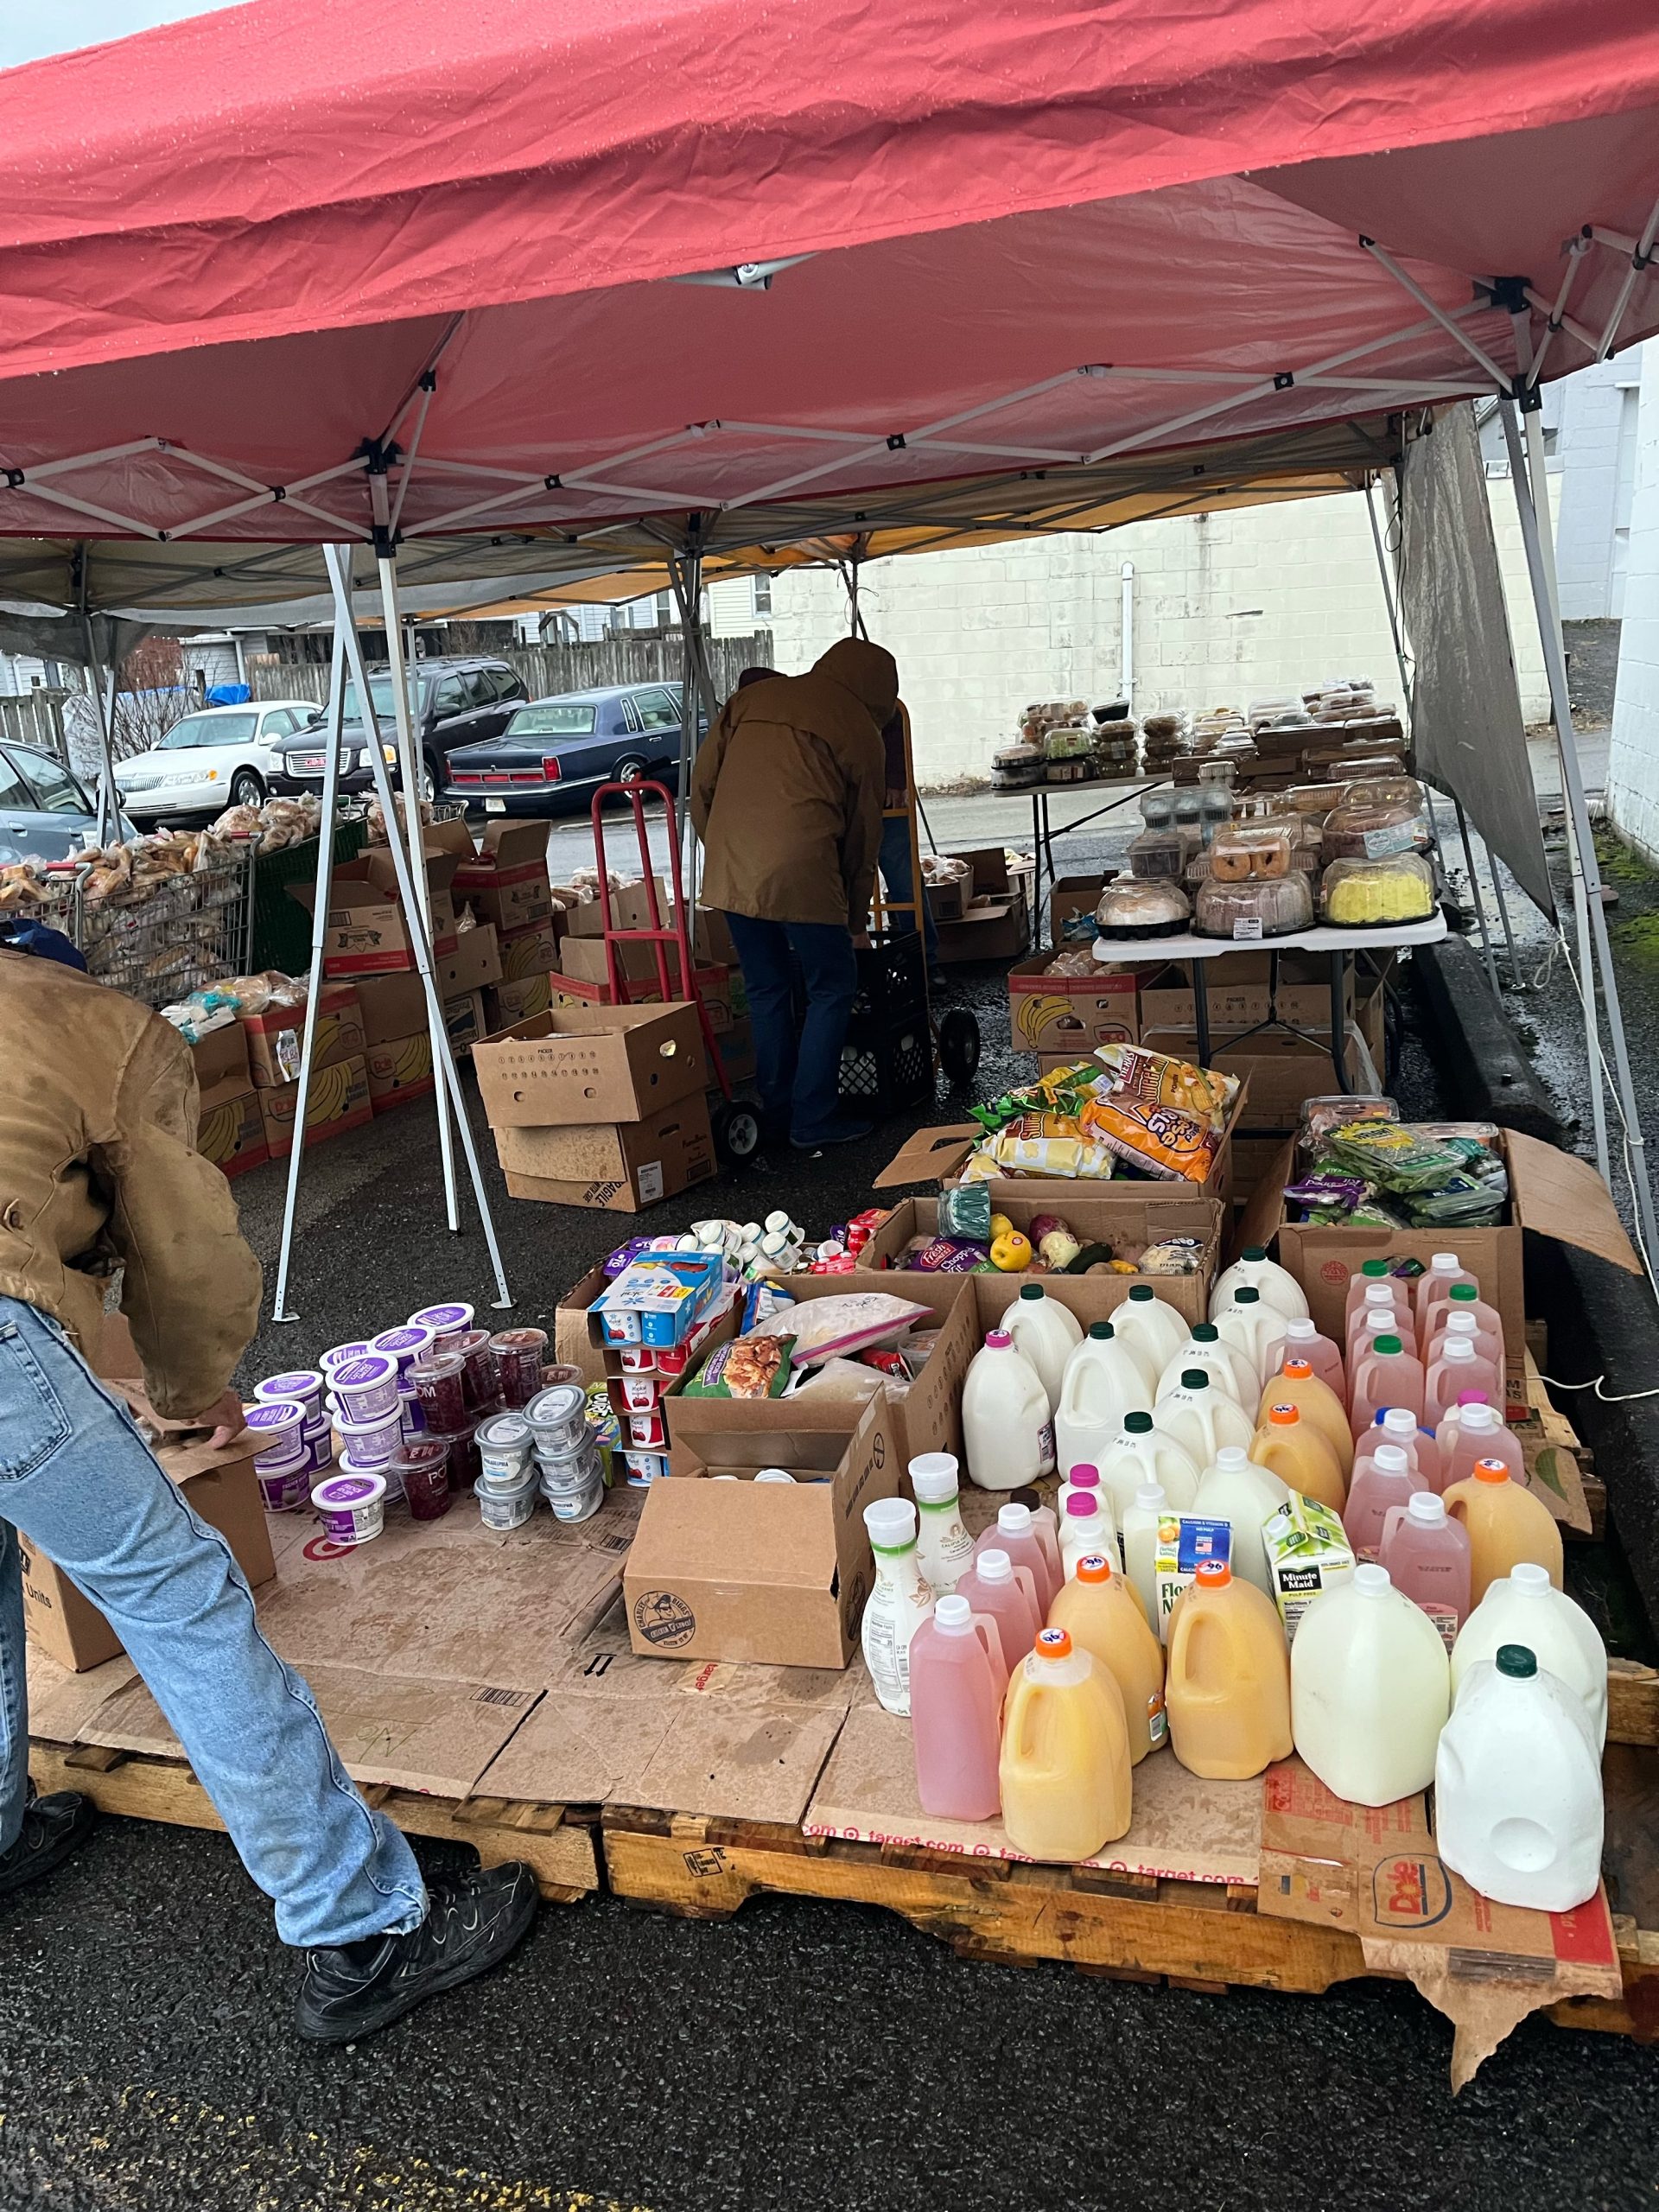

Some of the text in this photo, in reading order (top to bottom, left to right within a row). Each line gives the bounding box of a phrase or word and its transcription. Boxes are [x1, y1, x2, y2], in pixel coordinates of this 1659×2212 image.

[923, 1244, 946, 1262] Fresh
[416, 1386, 436, 1398] OM
[428, 1463, 448, 1485] PO
[1282, 1572, 1318, 1583] Minute
[1288, 1579, 1314, 1589] Maid
[26, 1582, 52, 1609] Units
[636, 1597, 690, 1629] CHARLEY BIGGS
[1387, 1860, 1421, 1915] Dole
